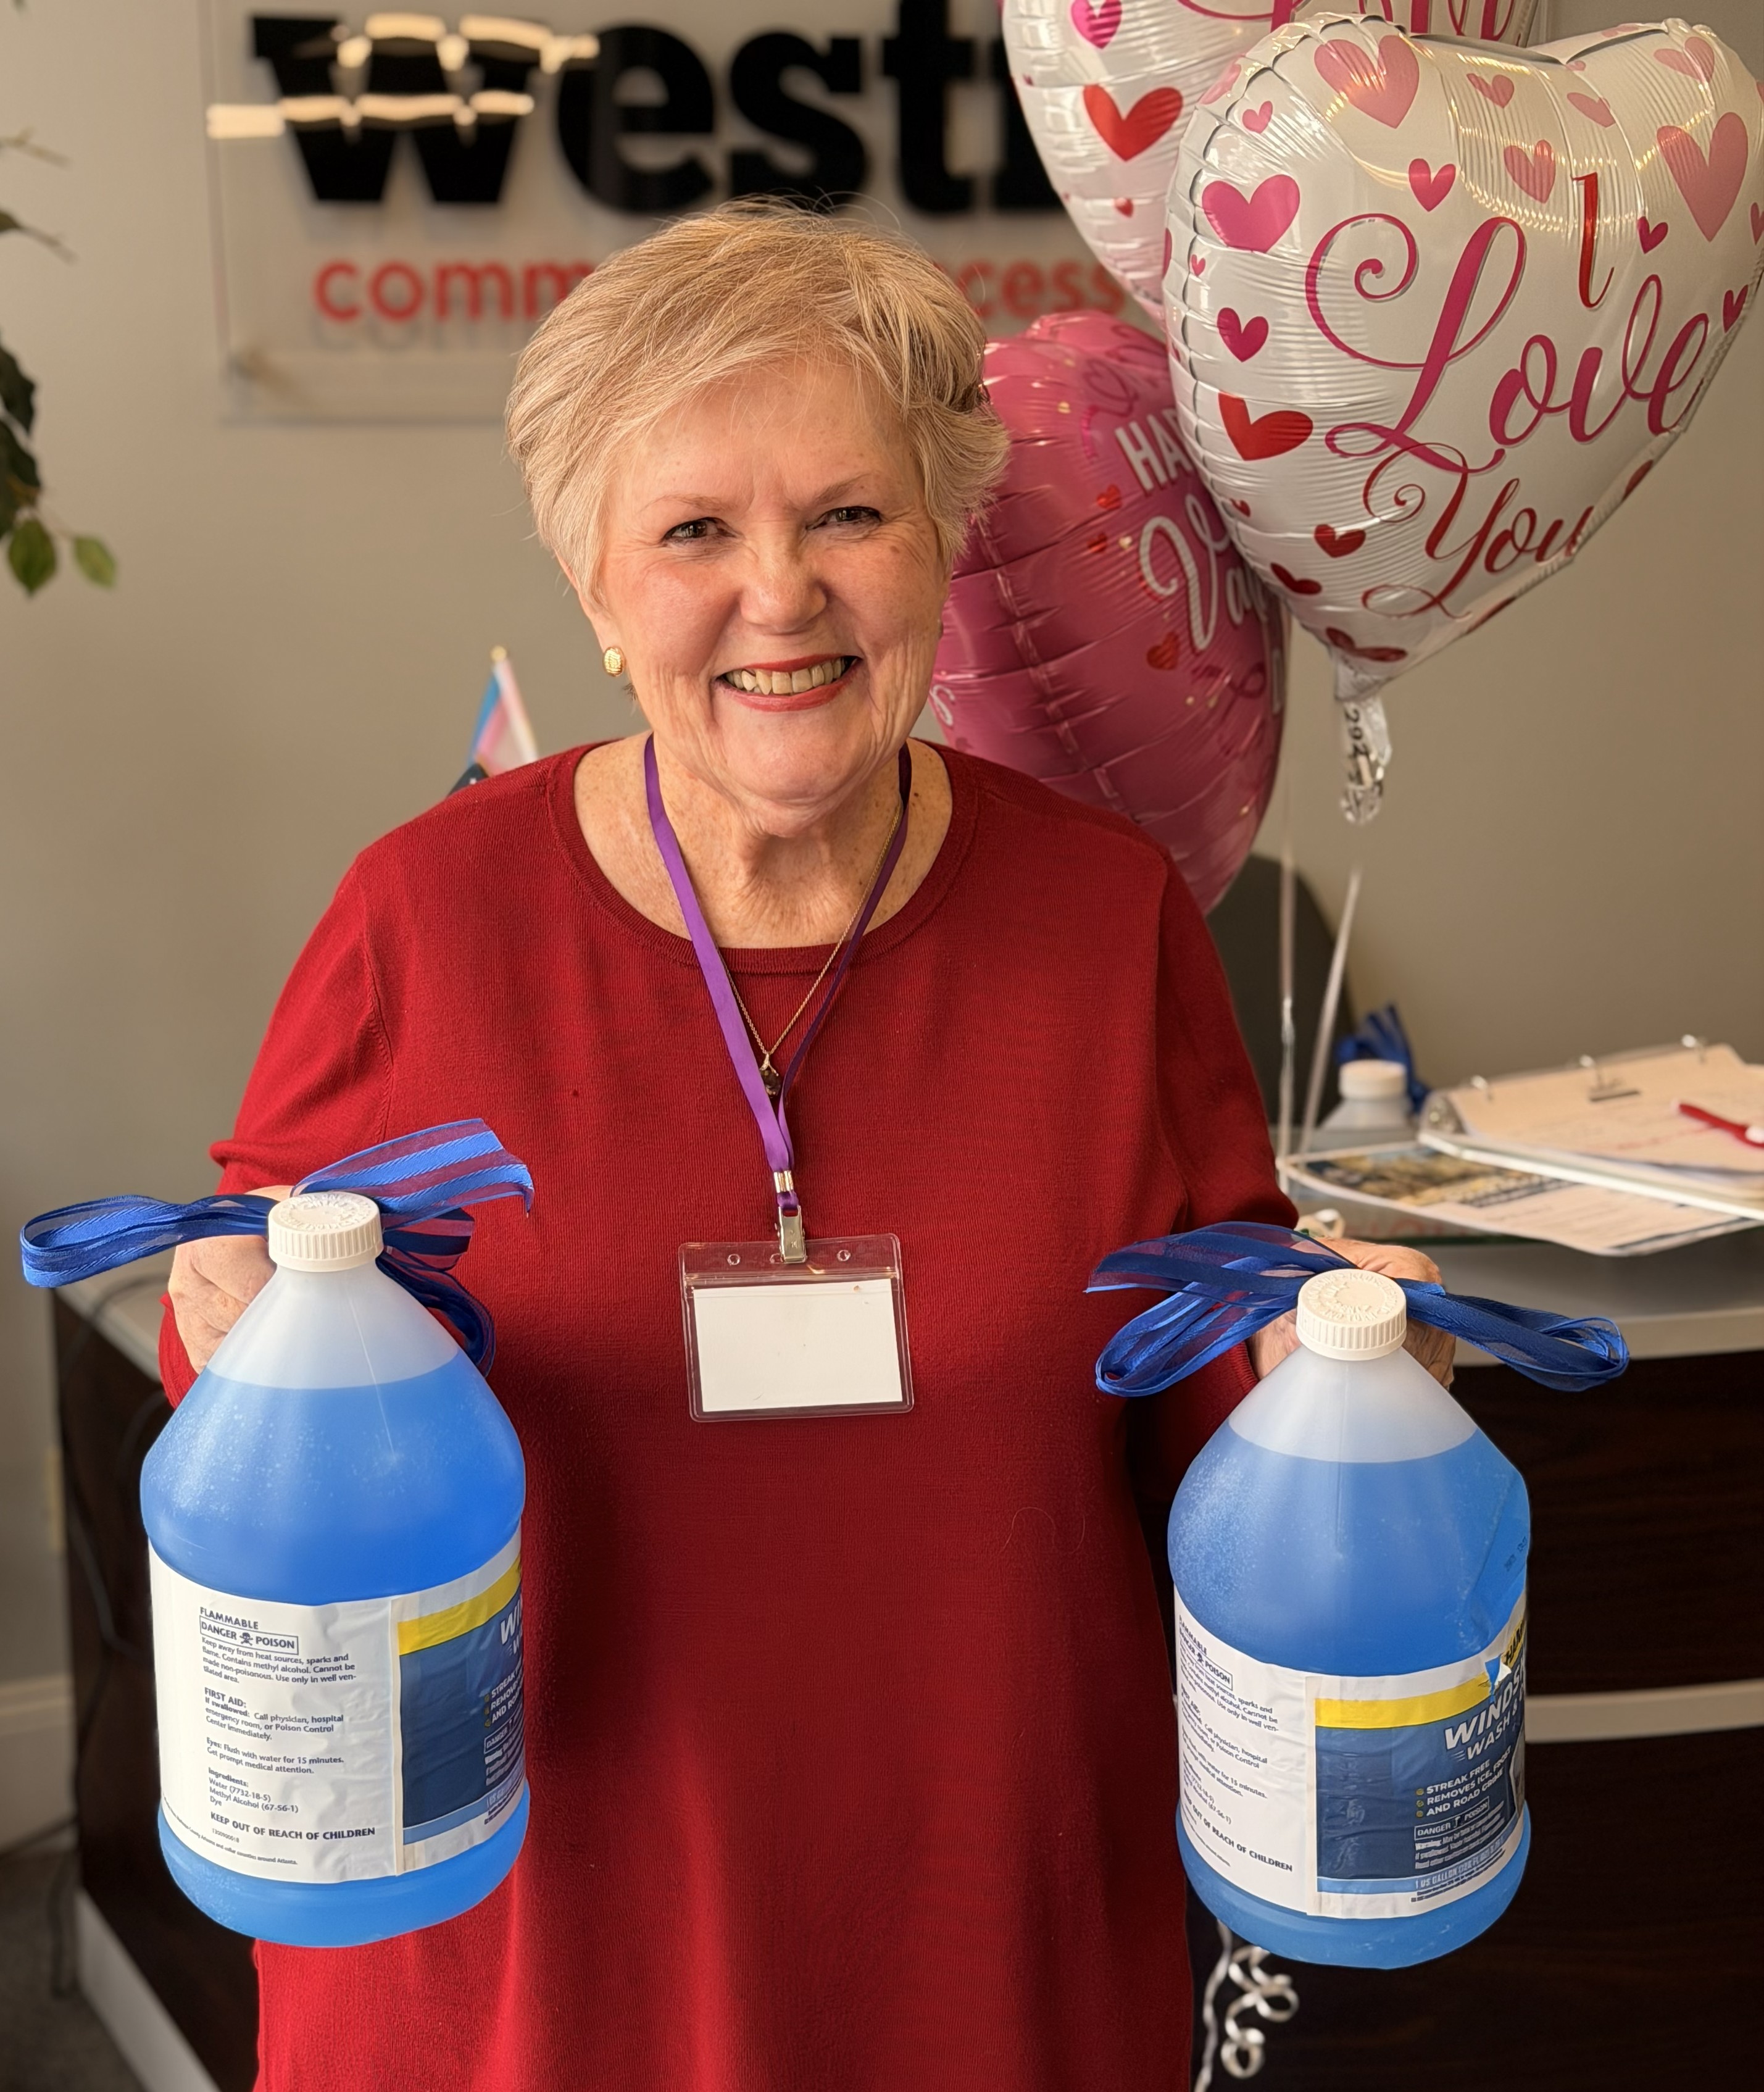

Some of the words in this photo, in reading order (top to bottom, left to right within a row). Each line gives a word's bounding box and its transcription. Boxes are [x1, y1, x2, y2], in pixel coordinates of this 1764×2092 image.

[314, 259, 594, 323] comm
[1304, 213, 1708, 474] Love
[1115, 409, 1193, 491] HA
[1362, 441, 1595, 619] You
[200, 1606, 259, 1630] FLAMMABLE
[201, 1621, 237, 1640] DANGER
[256, 1636, 294, 1649] POISON
[202, 1636, 217, 1649] Keep
[218, 1644, 235, 1655] away
[236, 1648, 254, 1657] from
[256, 1651, 272, 1661] heat
[274, 1656, 304, 1665] sources,
[306, 1656, 331, 1665] sparks
[333, 1653, 349, 1662] and
[222, 1653, 252, 1667] Contains
[254, 1662, 279, 1672] methyl
[281, 1665, 312, 1673] alcohol.
[313, 1665, 343, 1673] Cannot
[203, 1657, 220, 1667] made
[221, 1663, 274, 1680] non-poisonous.
[275, 1674, 289, 1682] Use
[291, 1676, 309, 1685] only
[224, 1674, 239, 1683] area.
[1205, 1660, 1231, 1685] POISON
[205, 1686, 226, 1702] FIRST
[228, 1696, 247, 1709] AID:
[1238, 1697, 1259, 1709] sparks
[1259, 1706, 1273, 1714] and
[206, 1707, 239, 1725] emergency
[275, 1723, 301, 1732] Poison
[304, 1724, 334, 1733] Control
[254, 1712, 268, 1720] Call
[270, 1714, 309, 1724] physician,
[312, 1714, 343, 1724] hospital
[492, 1705, 507, 1723] AND
[1227, 1708, 1242, 1719] only
[1249, 1718, 1262, 1728] well
[1263, 1723, 1279, 1732] ven-
[1243, 1707, 1267, 1721] Cannot
[1268, 1715, 1278, 1724] be
[206, 1715, 226, 1728] Center
[228, 1723, 272, 1741] immediately.
[1467, 1711, 1511, 1760] WASH
[207, 1737, 222, 1749] Eyes:
[224, 1743, 240, 1755] Flush
[241, 1751, 257, 1759] with
[259, 1755, 281, 1763] water
[283, 1756, 294, 1764] for
[207, 1746, 217, 1756] Get
[220, 1753, 243, 1765] prompt
[245, 1761, 273, 1771] medical
[275, 1765, 314, 1774] attention.
[1234, 1753, 1259, 1769] Control
[1241, 1748, 1268, 1764] hospital
[209, 1767, 249, 1787] Ingredients:
[1230, 1777, 1238, 1786] 15
[1426, 1773, 1468, 1794] STREAK
[1470, 1759, 1491, 1779] FREE
[1427, 1780, 1476, 1806] REMOVES
[1478, 1770, 1492, 1785] ICE,
[209, 1777, 228, 1790] Water
[230, 1785, 271, 1802] (7732-18-5)
[210, 1786, 231, 1801] Methyl
[233, 1796, 259, 1809] Alcohol
[262, 1802, 299, 1813] (67-56-1)
[210, 1796, 222, 1806] Dye
[1426, 1802, 1450, 1817] AND
[1453, 1789, 1480, 1808] ROAD
[210, 1811, 230, 1825] KEEP
[232, 1820, 250, 1832] OUT
[253, 1827, 265, 1835] OF
[268, 1828, 302, 1840] REACH
[306, 1831, 320, 1840] OF
[322, 1827, 376, 1840] CHILDREN
[1417, 1822, 1451, 1836] DANGER
[1203, 1817, 1211, 1828] OF
[1212, 1825, 1234, 1848] REACH
[1236, 1843, 1247, 1853] OF
[1249, 1849, 1293, 1872] CHILDREN
[1420, 1878, 1430, 1888] US
[1433, 1869, 1457, 1885] GALLON
